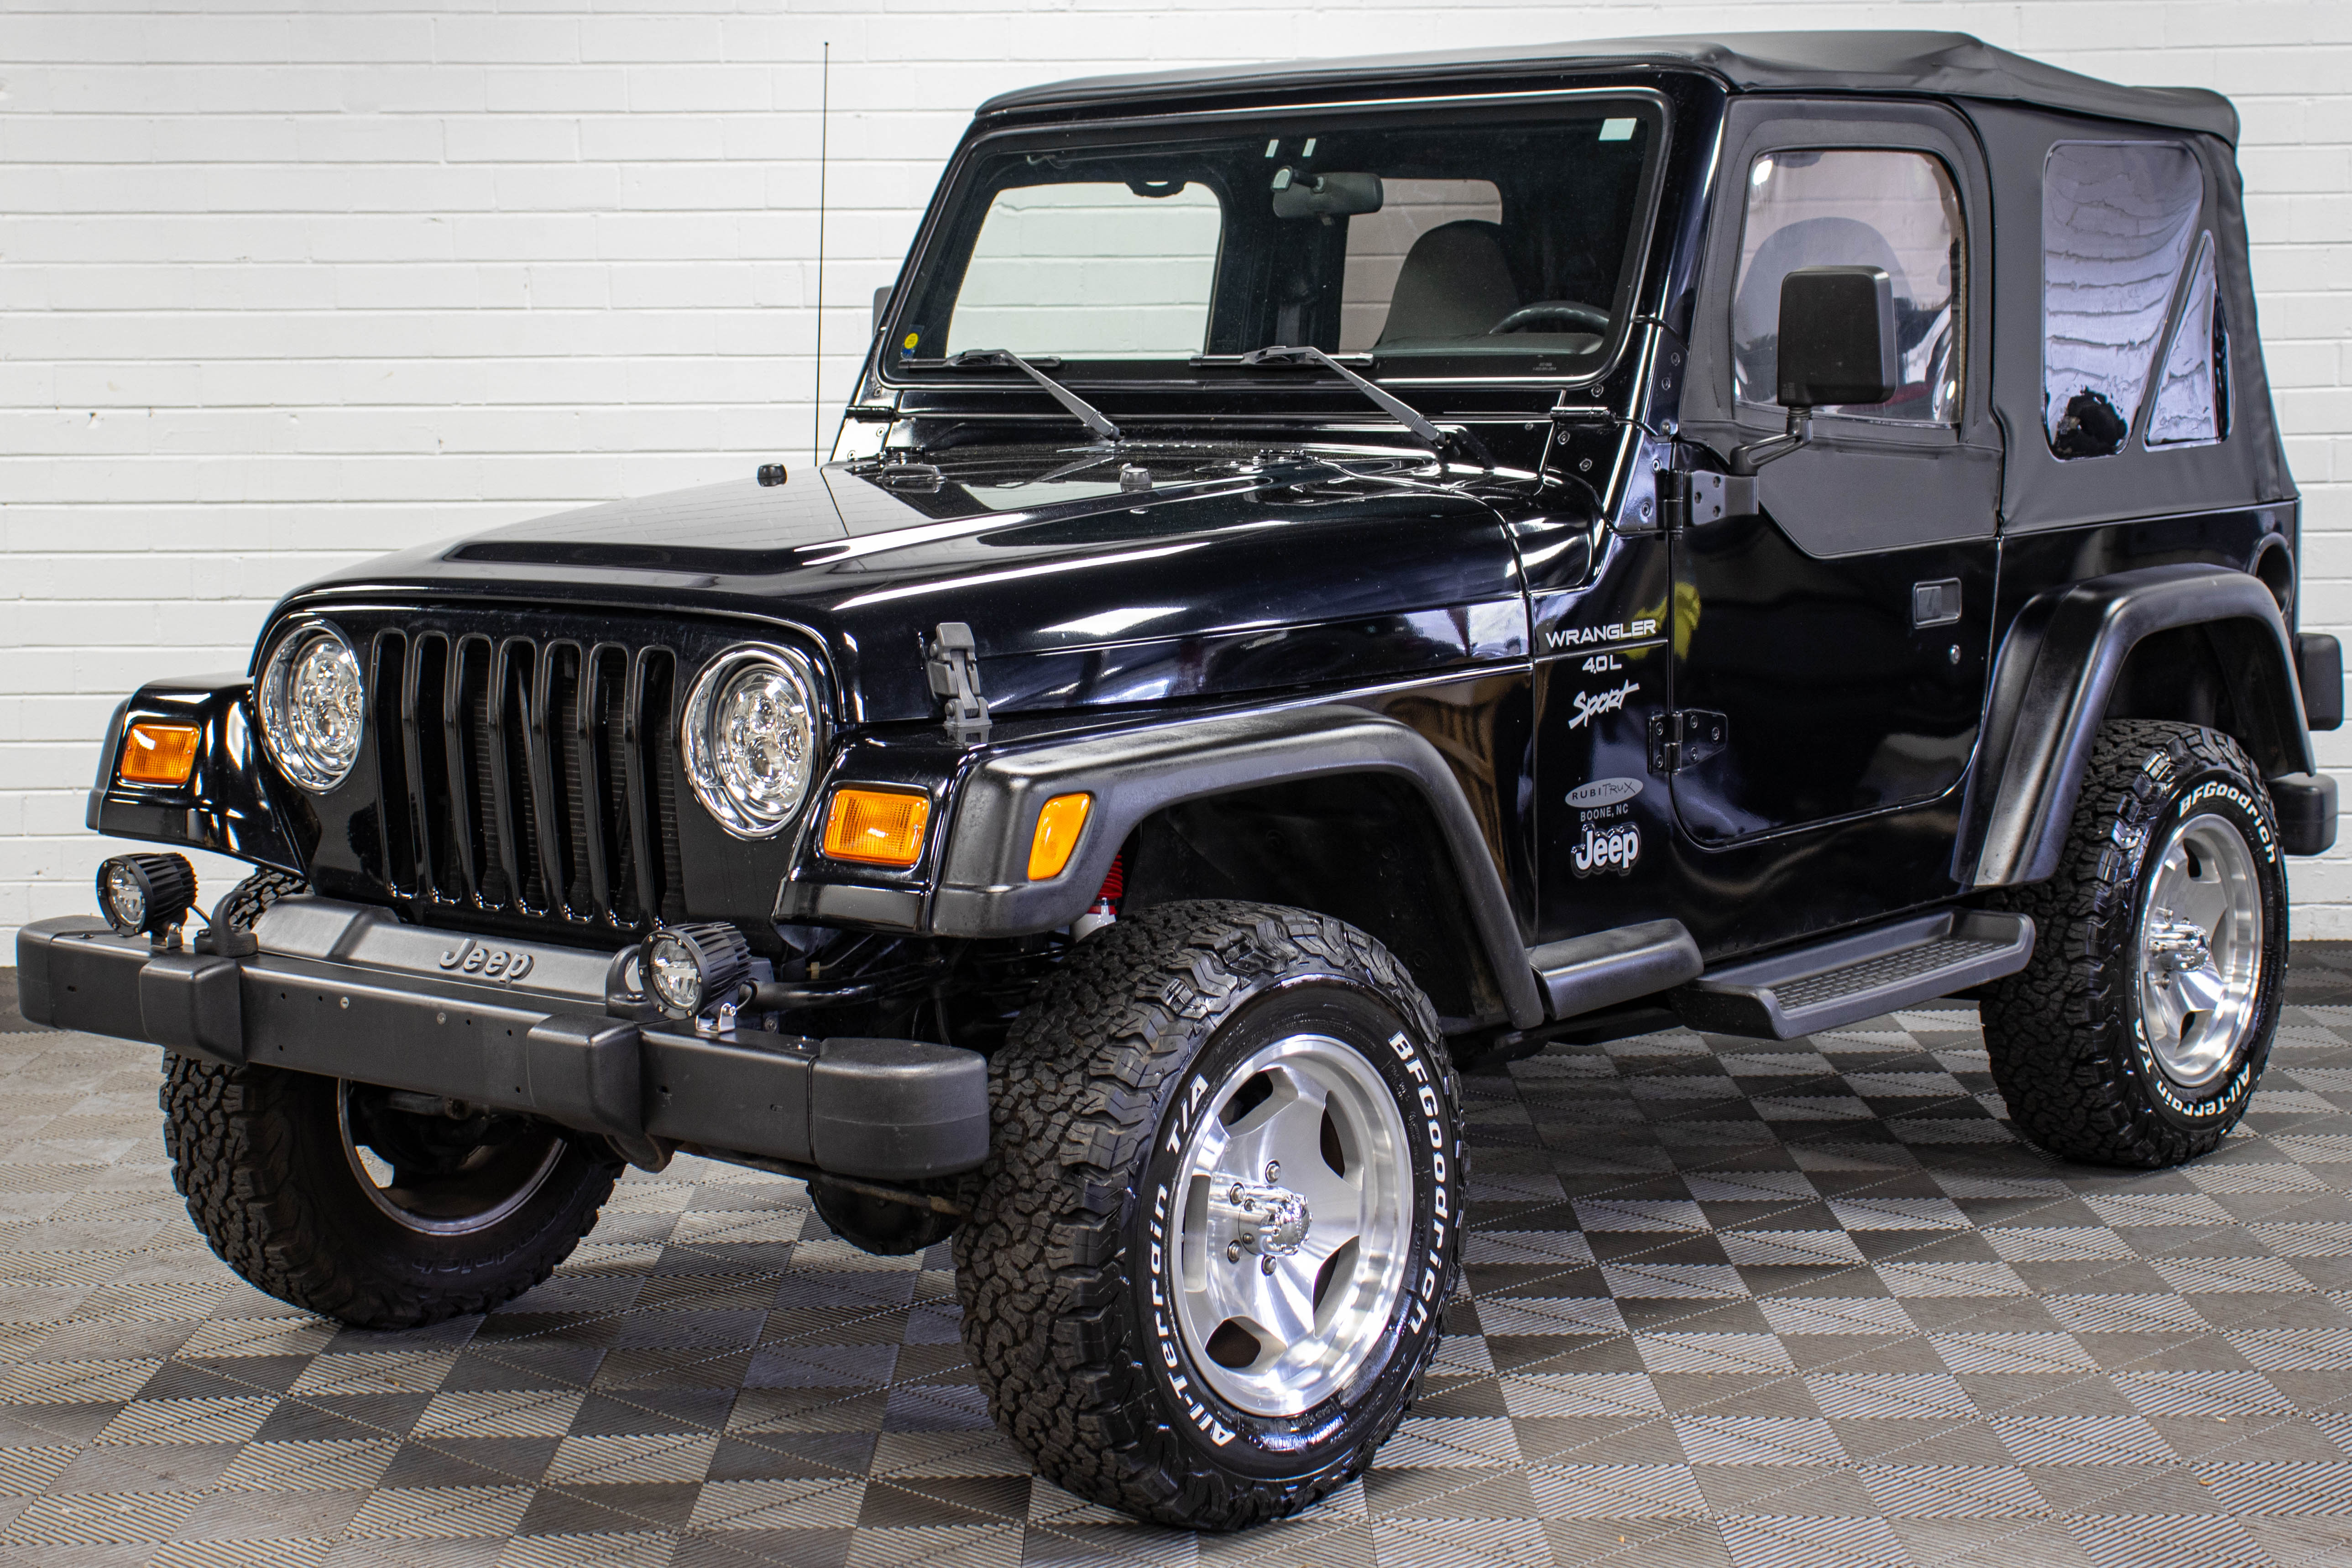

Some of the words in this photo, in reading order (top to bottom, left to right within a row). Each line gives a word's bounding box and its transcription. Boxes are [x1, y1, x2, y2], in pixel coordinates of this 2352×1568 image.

[1546, 619, 1656, 648] WRANGLER
[1580, 807, 1614, 821] BOONE,
[1616, 803, 1628, 814] NC
[2178, 781, 2276, 864] BFGoodrich
[1576, 831, 1638, 869] Jeep
[439, 938, 534, 983] Jeep
[2134, 1018, 2152, 1074] T/A
[1166, 1074, 1208, 1156] T/A
[2156, 1062, 2250, 1117] All-Terrain
[1388, 1030, 1448, 1335] BFGoodrich
[1150, 1184, 1236, 1447] All-Terrain
